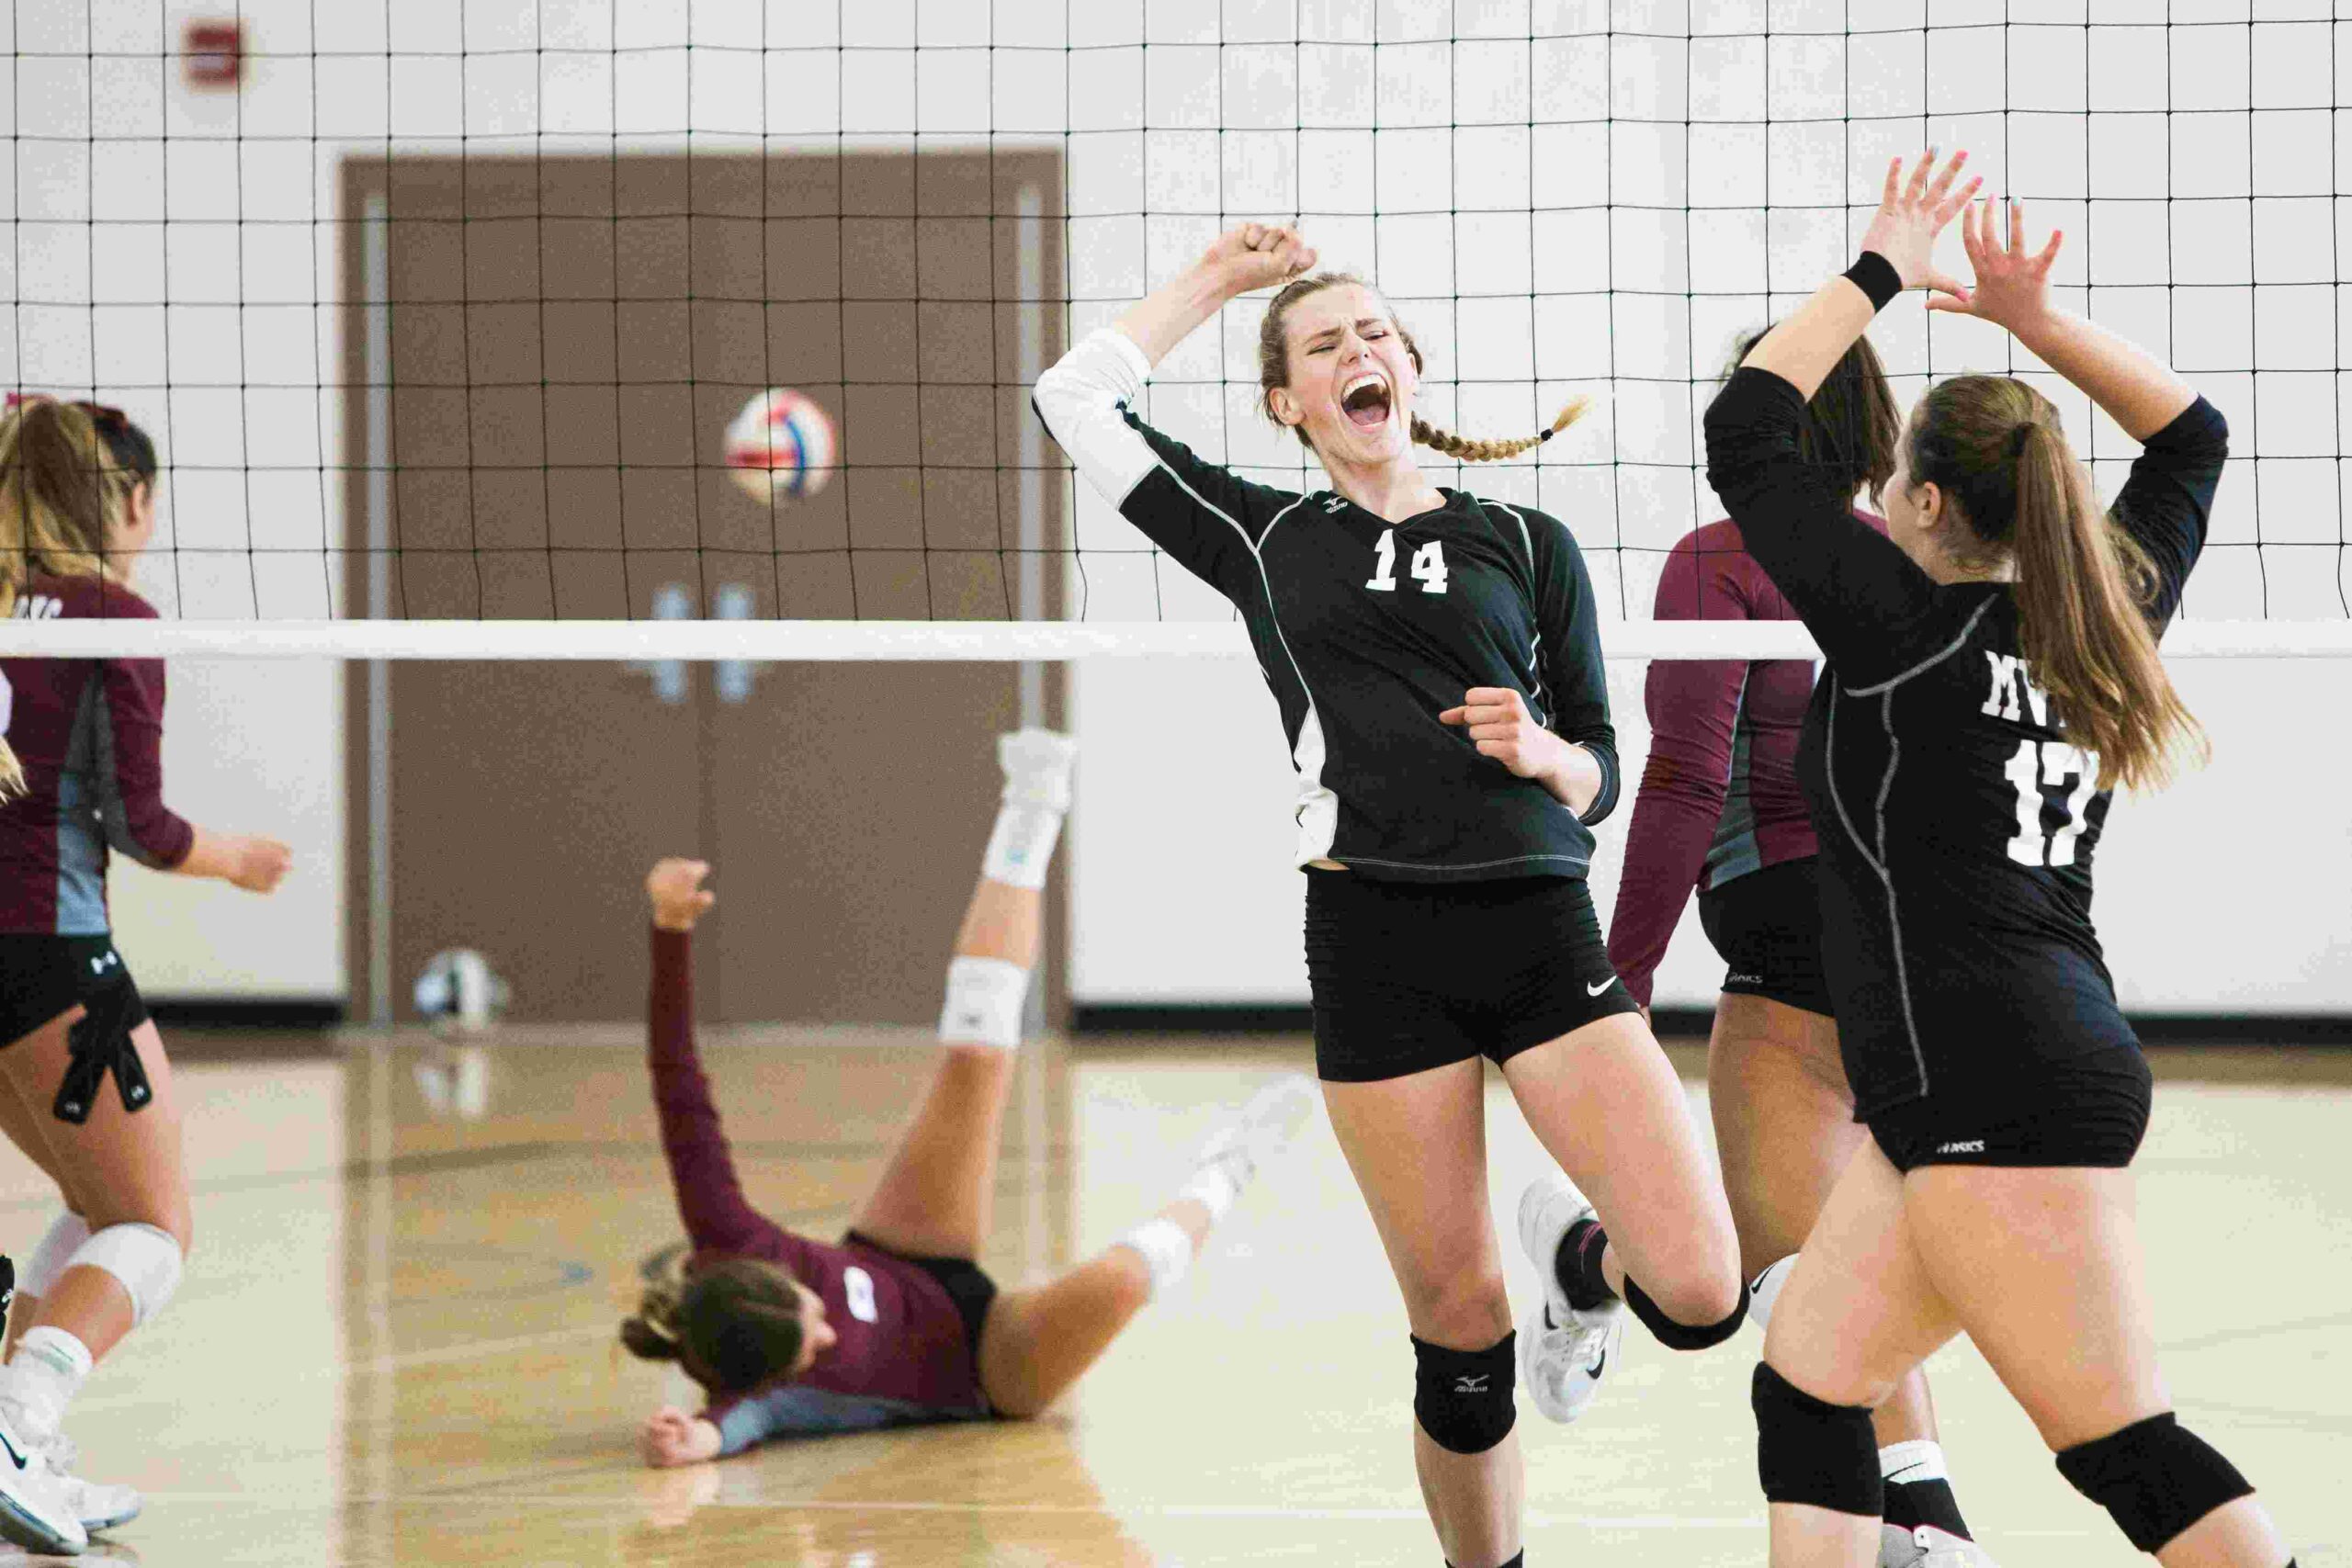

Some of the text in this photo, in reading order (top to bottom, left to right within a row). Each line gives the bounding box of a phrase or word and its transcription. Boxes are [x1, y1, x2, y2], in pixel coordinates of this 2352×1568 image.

[1365, 528, 1448, 593] 14
[1981, 649, 2067, 727] MV
[2005, 739, 2100, 866] 17
